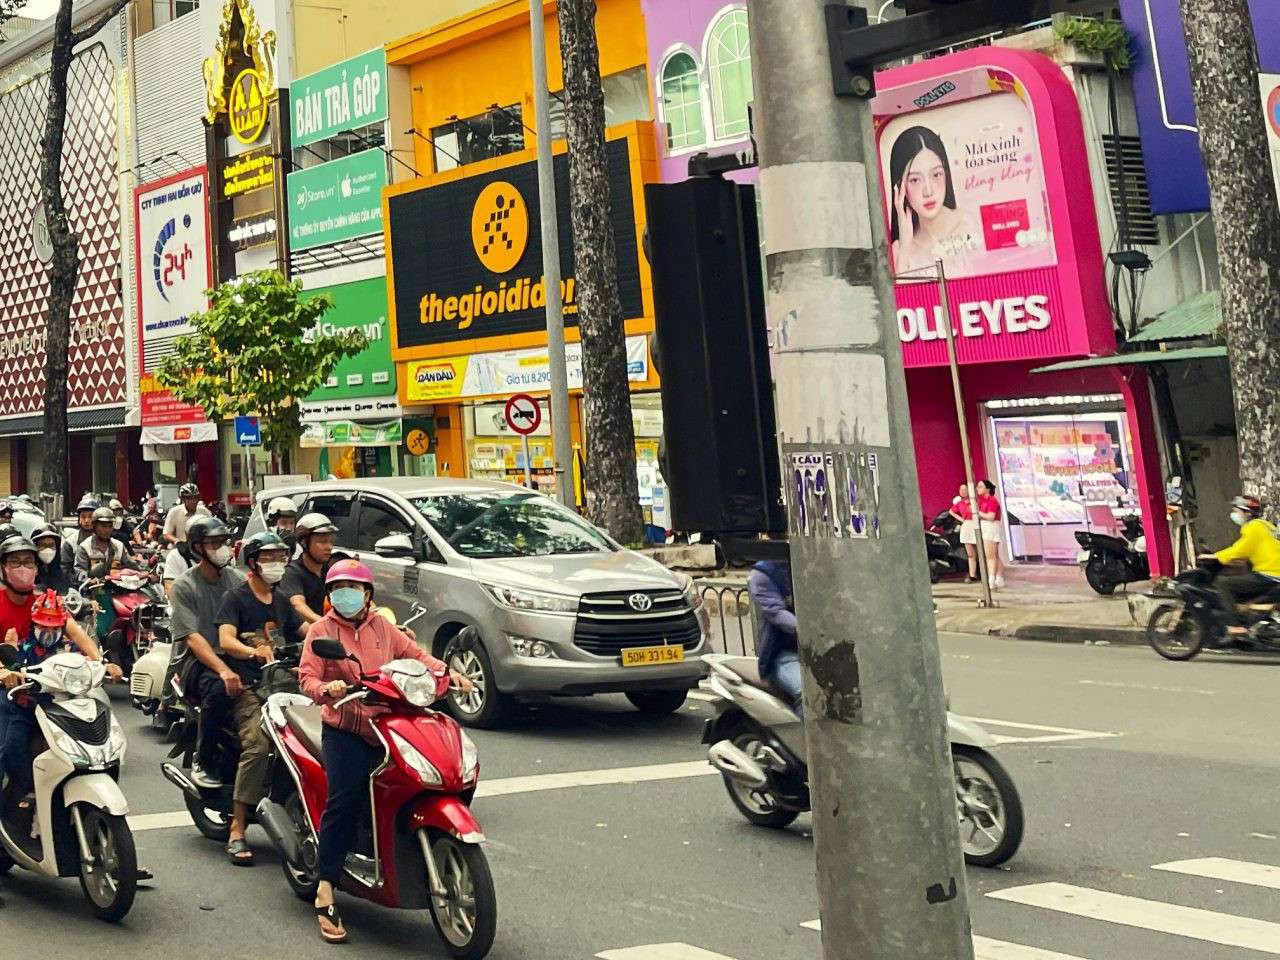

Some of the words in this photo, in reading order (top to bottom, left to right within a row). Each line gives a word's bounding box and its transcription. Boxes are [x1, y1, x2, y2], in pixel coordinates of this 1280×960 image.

[295, 86, 322, 138] BÁN
[325, 69, 351, 128] TRẢ
[353, 64, 381, 119] GÓP
[163, 243, 192, 287] 24h
[897, 305, 958, 342] OLL
[959, 294, 1052, 338] EYES
